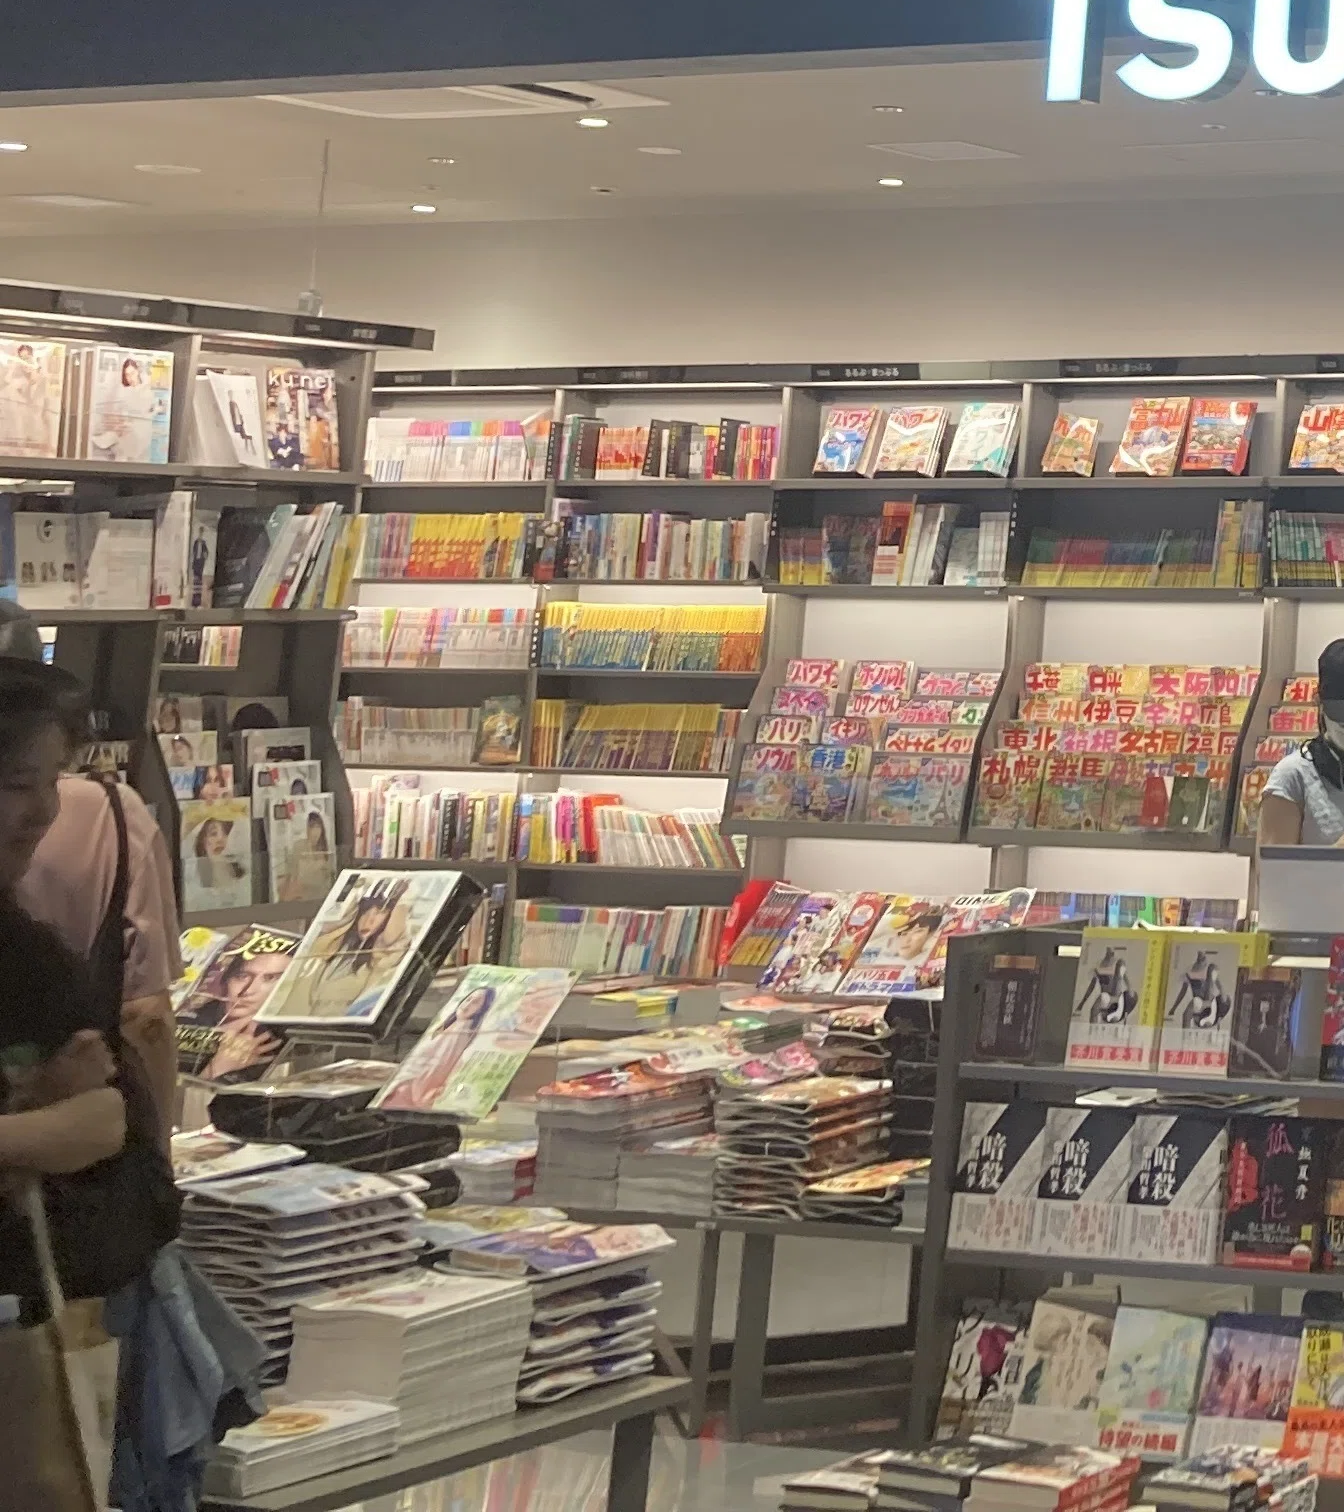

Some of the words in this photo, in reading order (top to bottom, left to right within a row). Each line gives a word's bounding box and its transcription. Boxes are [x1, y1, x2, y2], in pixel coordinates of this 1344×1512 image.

[1131, 404, 1186, 430] 富士山
[791, 661, 838, 684] ハワイ
[1152, 672, 1207, 696] 大阪
[1021, 700, 1079, 722] 信州
[1083, 699, 1140, 723] 伊豆
[766, 719, 803, 743] パリ
[1002, 728, 1058, 751] 東北
[1119, 729, 1182, 753] 名古屋
[979, 1133, 1008, 1190] 暗殺
[1063, 1138, 1091, 1196] 暗殺
[1152, 1144, 1180, 1201] 暗殺
[1097, 1426, 1178, 1453] 待望の続編
